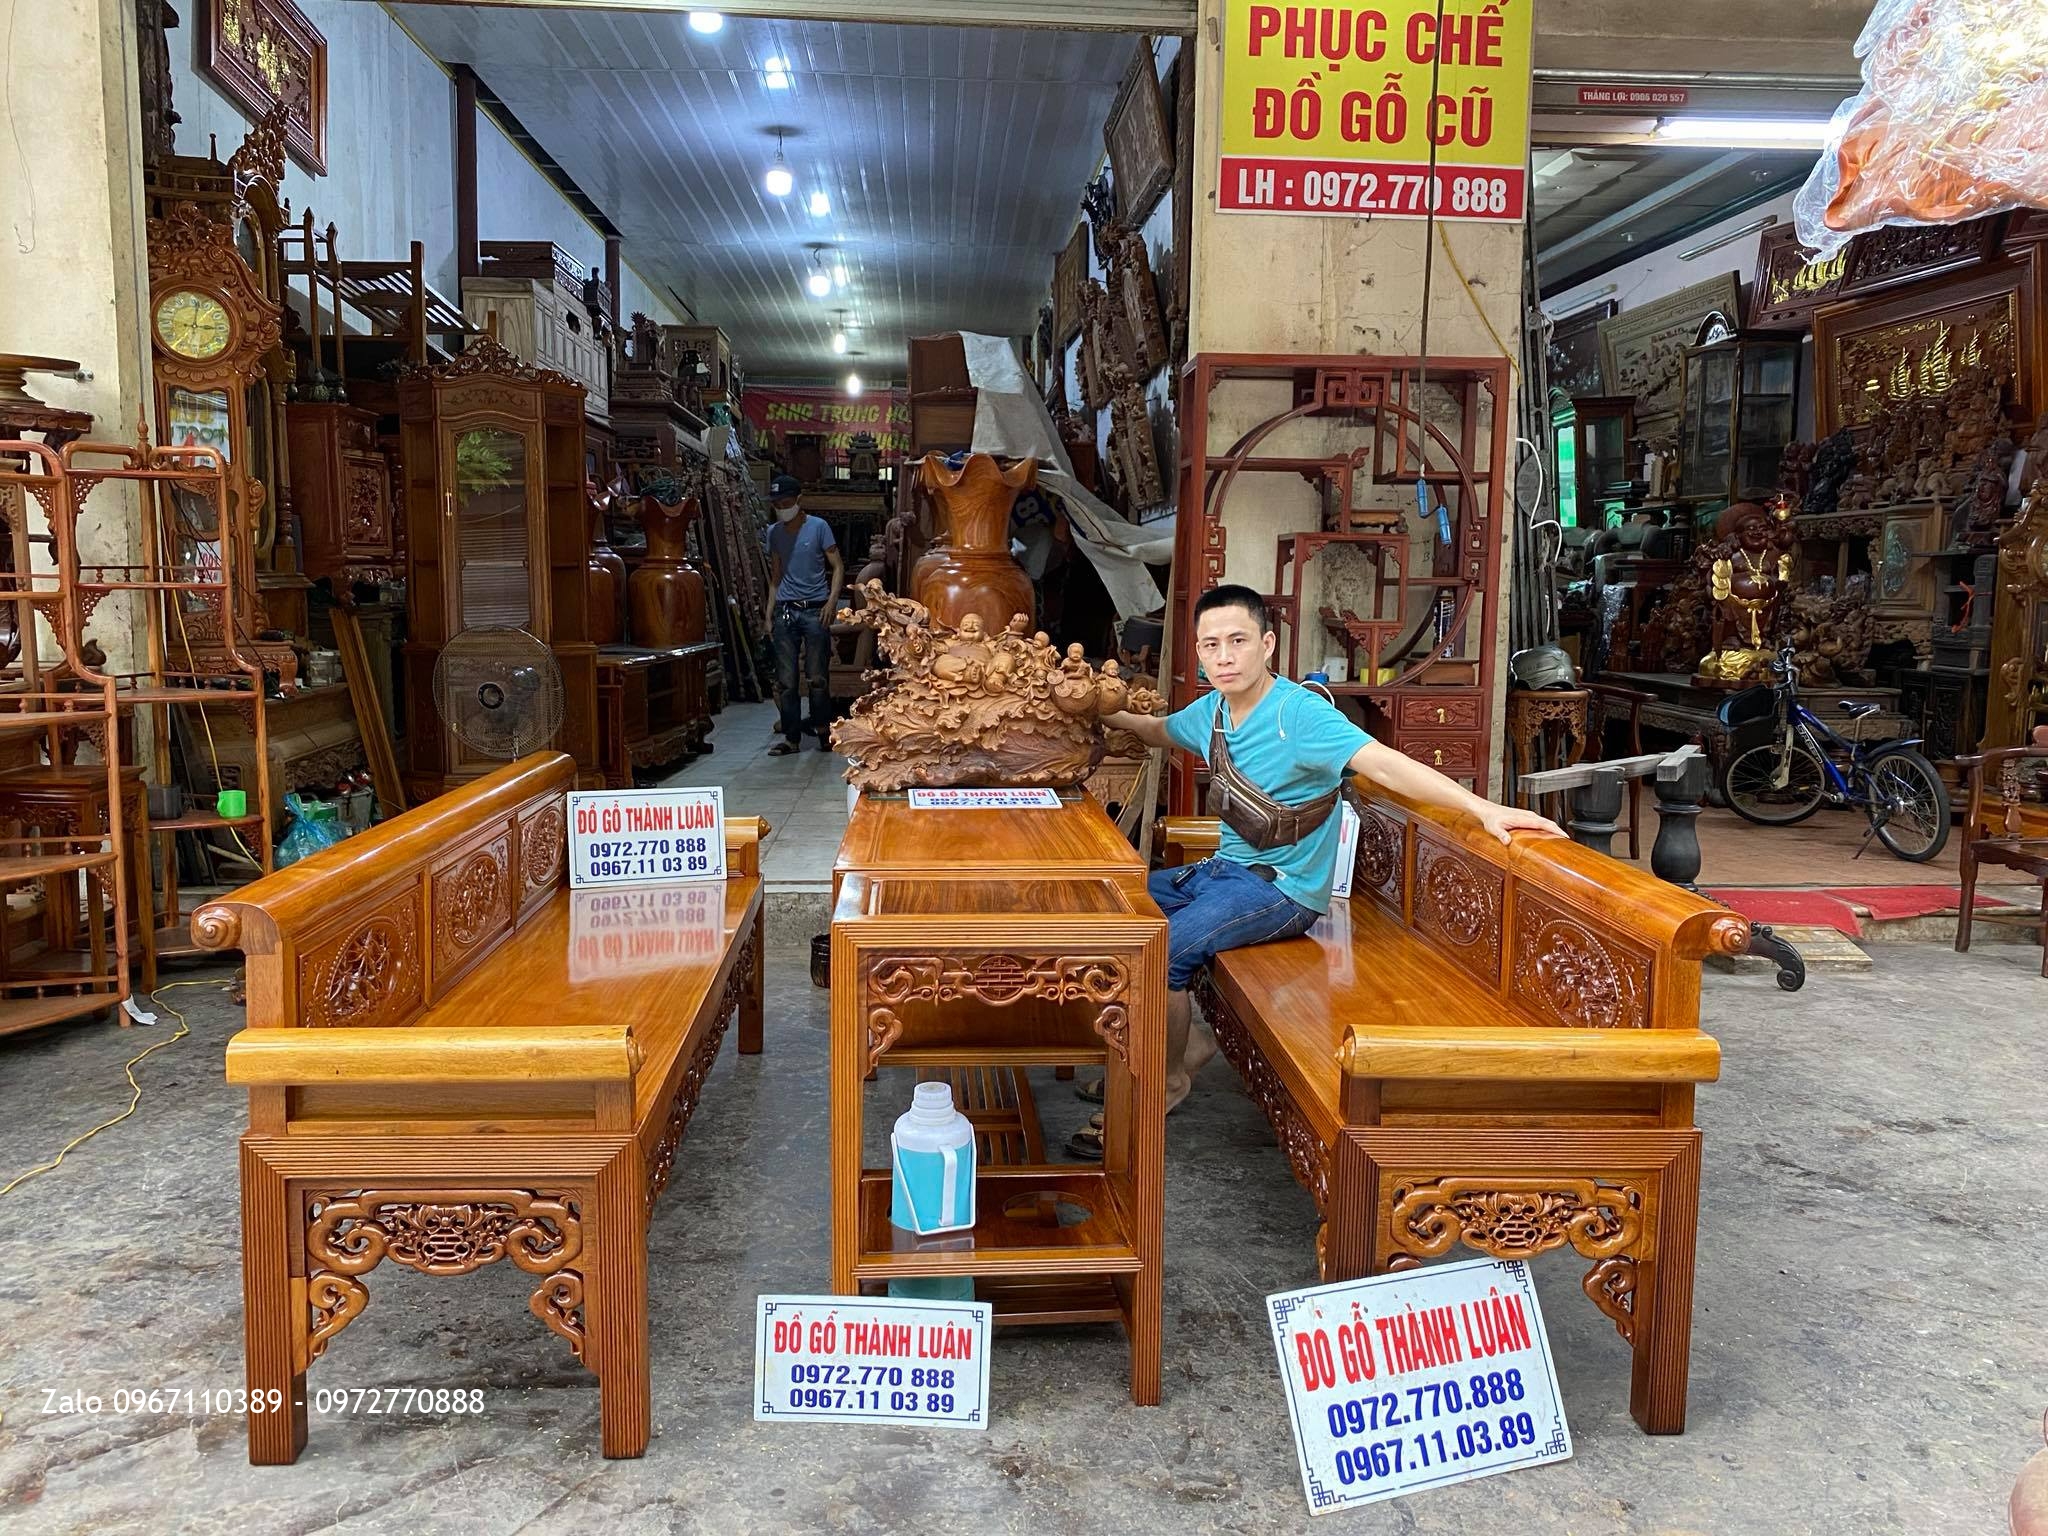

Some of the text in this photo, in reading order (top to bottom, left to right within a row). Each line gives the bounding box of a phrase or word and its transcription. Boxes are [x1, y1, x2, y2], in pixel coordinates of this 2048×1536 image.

[1248, 0, 1510, 72] PHỤC CHẾ
[1253, 71, 1493, 147] ĐỒ GỖ CŨ
[1238, 168, 1276, 204] LH
[1303, 170, 1442, 211] 0972.770
[1452, 176, 1507, 213] 888
[766, 403, 813, 422] SANG
[602, 800, 622, 834] GỖ
[625, 803, 673, 832] THÀNH
[678, 801, 714, 829] LUÂN
[590, 838, 706, 858] 0972.770 888
[590, 856, 707, 876] 0967.11 03 89
[774, 1310, 972, 1360] ĐỒ GỖ THÀNH LUÂN
[1338, 1302, 1376, 1384] GỖ
[1375, 1303, 1463, 1375] THÀNH
[1461, 1286, 1531, 1360] LUÂN
[791, 1364, 955, 1389] 0972.770 888
[790, 1388, 954, 1413] 0967.11 03 89
[1327, 1368, 1525, 1438] 0972.770.888
[1335, 1412, 1536, 1485] 0967.11.03.89
